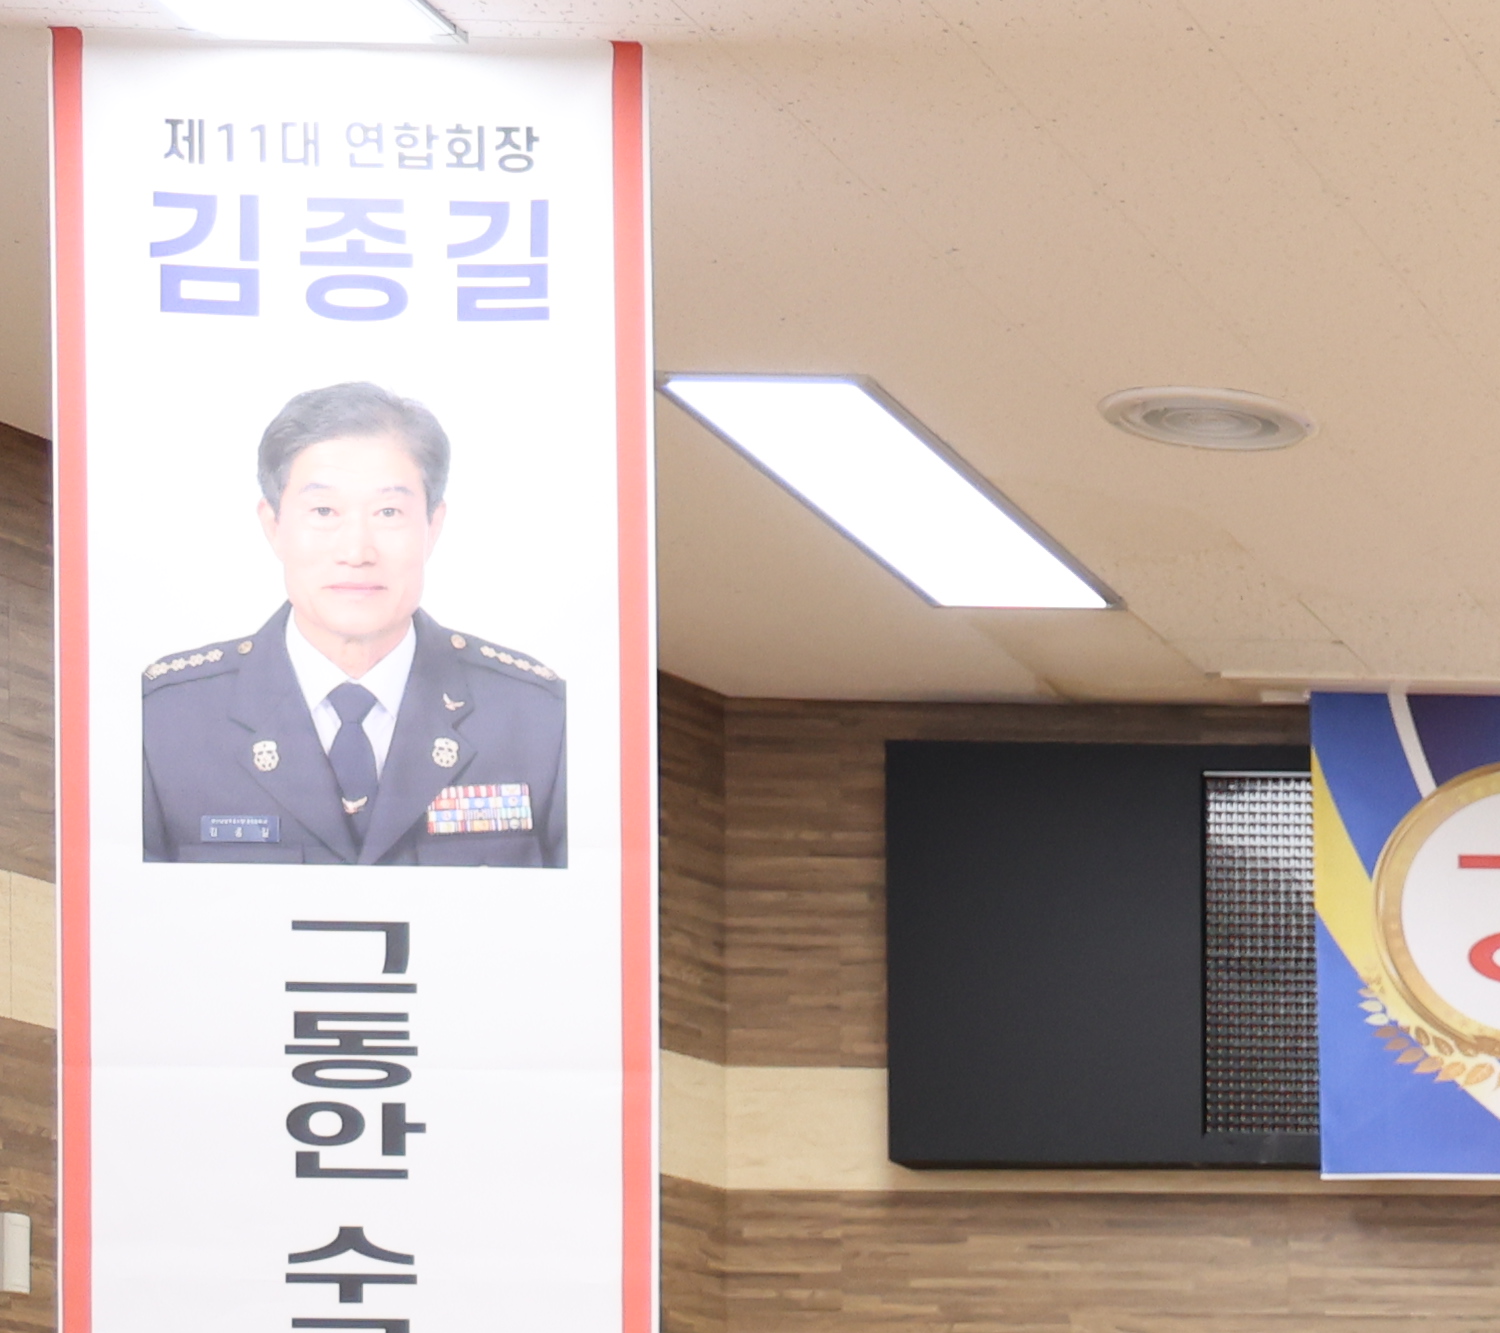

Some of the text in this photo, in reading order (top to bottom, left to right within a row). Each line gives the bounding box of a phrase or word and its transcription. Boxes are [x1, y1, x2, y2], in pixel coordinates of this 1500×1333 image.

[163, 117, 541, 174] 제11대 연합회장
[149, 191, 550, 322] 김종길
[283, 919, 428, 1180] 그동안
